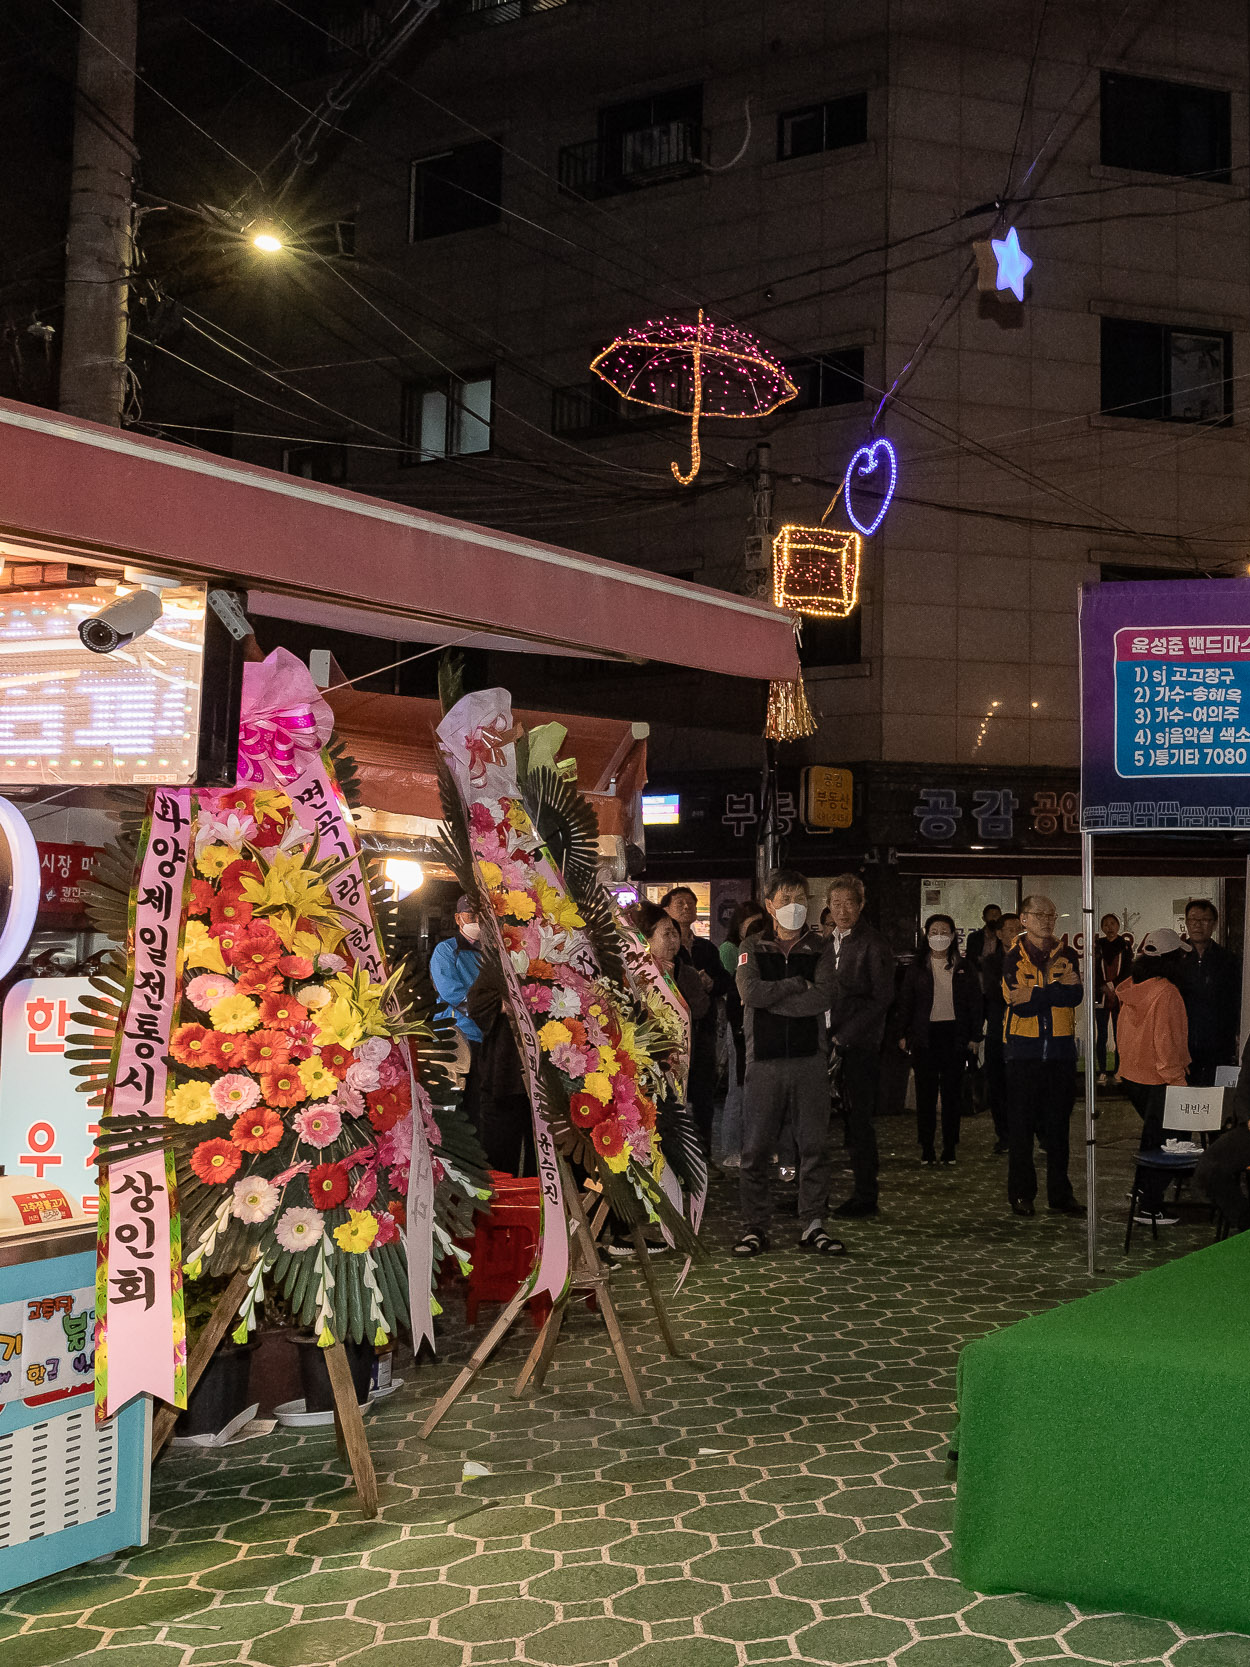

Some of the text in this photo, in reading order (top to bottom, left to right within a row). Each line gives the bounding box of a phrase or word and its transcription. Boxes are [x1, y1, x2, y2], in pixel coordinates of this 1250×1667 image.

[1131, 636, 1185, 656] 윤성준
[1134, 666, 1236, 686] 1) sj 고고장구
[1133, 686, 1243, 704] 2) 가수-송혜옥
[1134, 705, 1240, 725] 3) 가수-여의주
[1134, 728, 1151, 746] 4)
[1155, 726, 1215, 748] sj음악실
[1204, 747, 1247, 766] 7080
[721, 791, 798, 837] 부동
[913, 787, 1019, 841] 공감
[110, 796, 191, 1150] 화양제일전통시
[1179, 1101, 1211, 1116] 내빈석
[108, 1170, 165, 1312] 상인회
